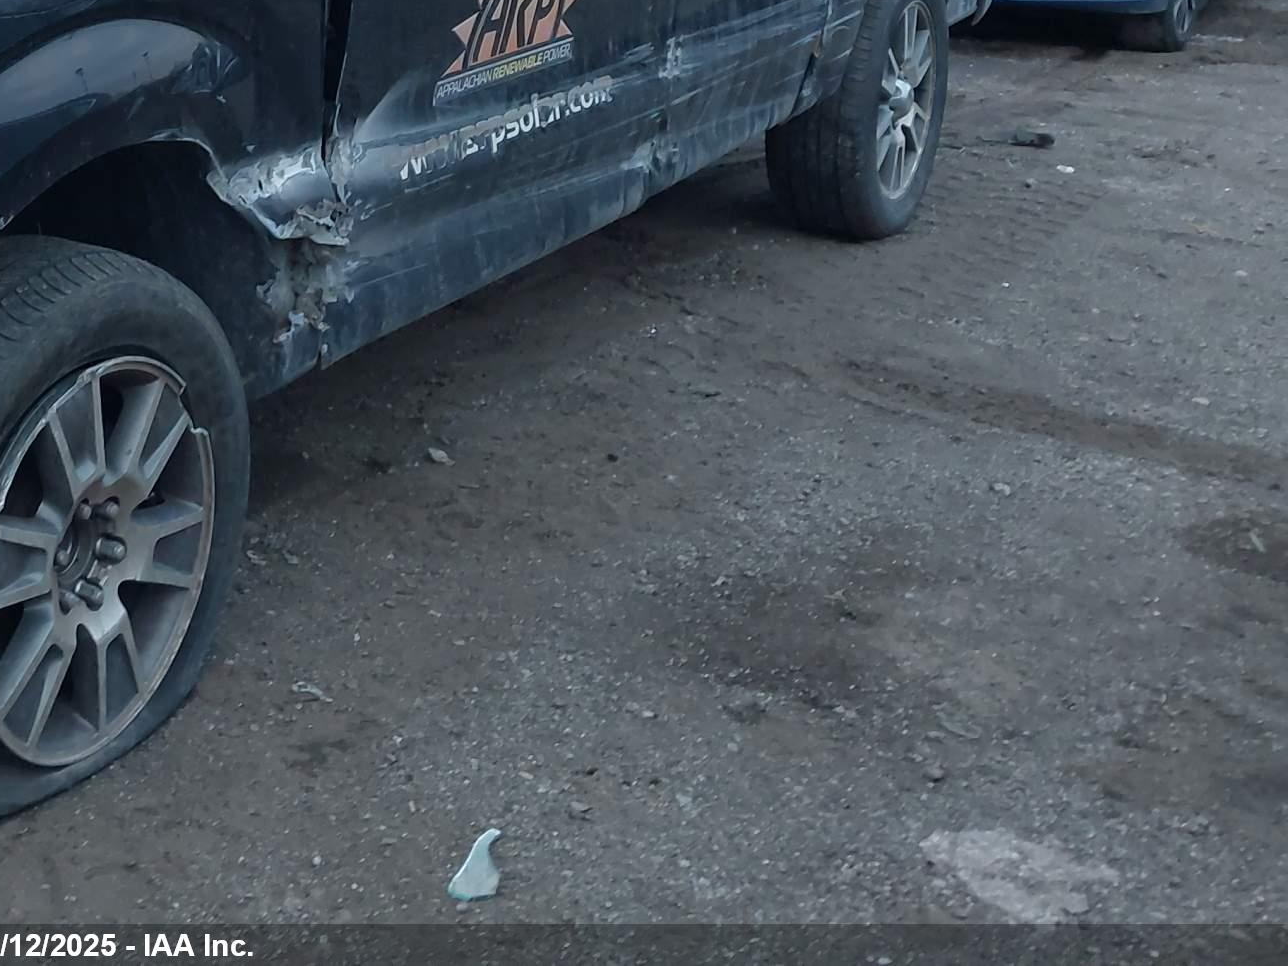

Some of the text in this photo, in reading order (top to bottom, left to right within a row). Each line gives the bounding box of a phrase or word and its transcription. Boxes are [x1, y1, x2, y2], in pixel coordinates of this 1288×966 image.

[436, 43, 572, 99] APPALACHIAN RENEWABLE POWER
